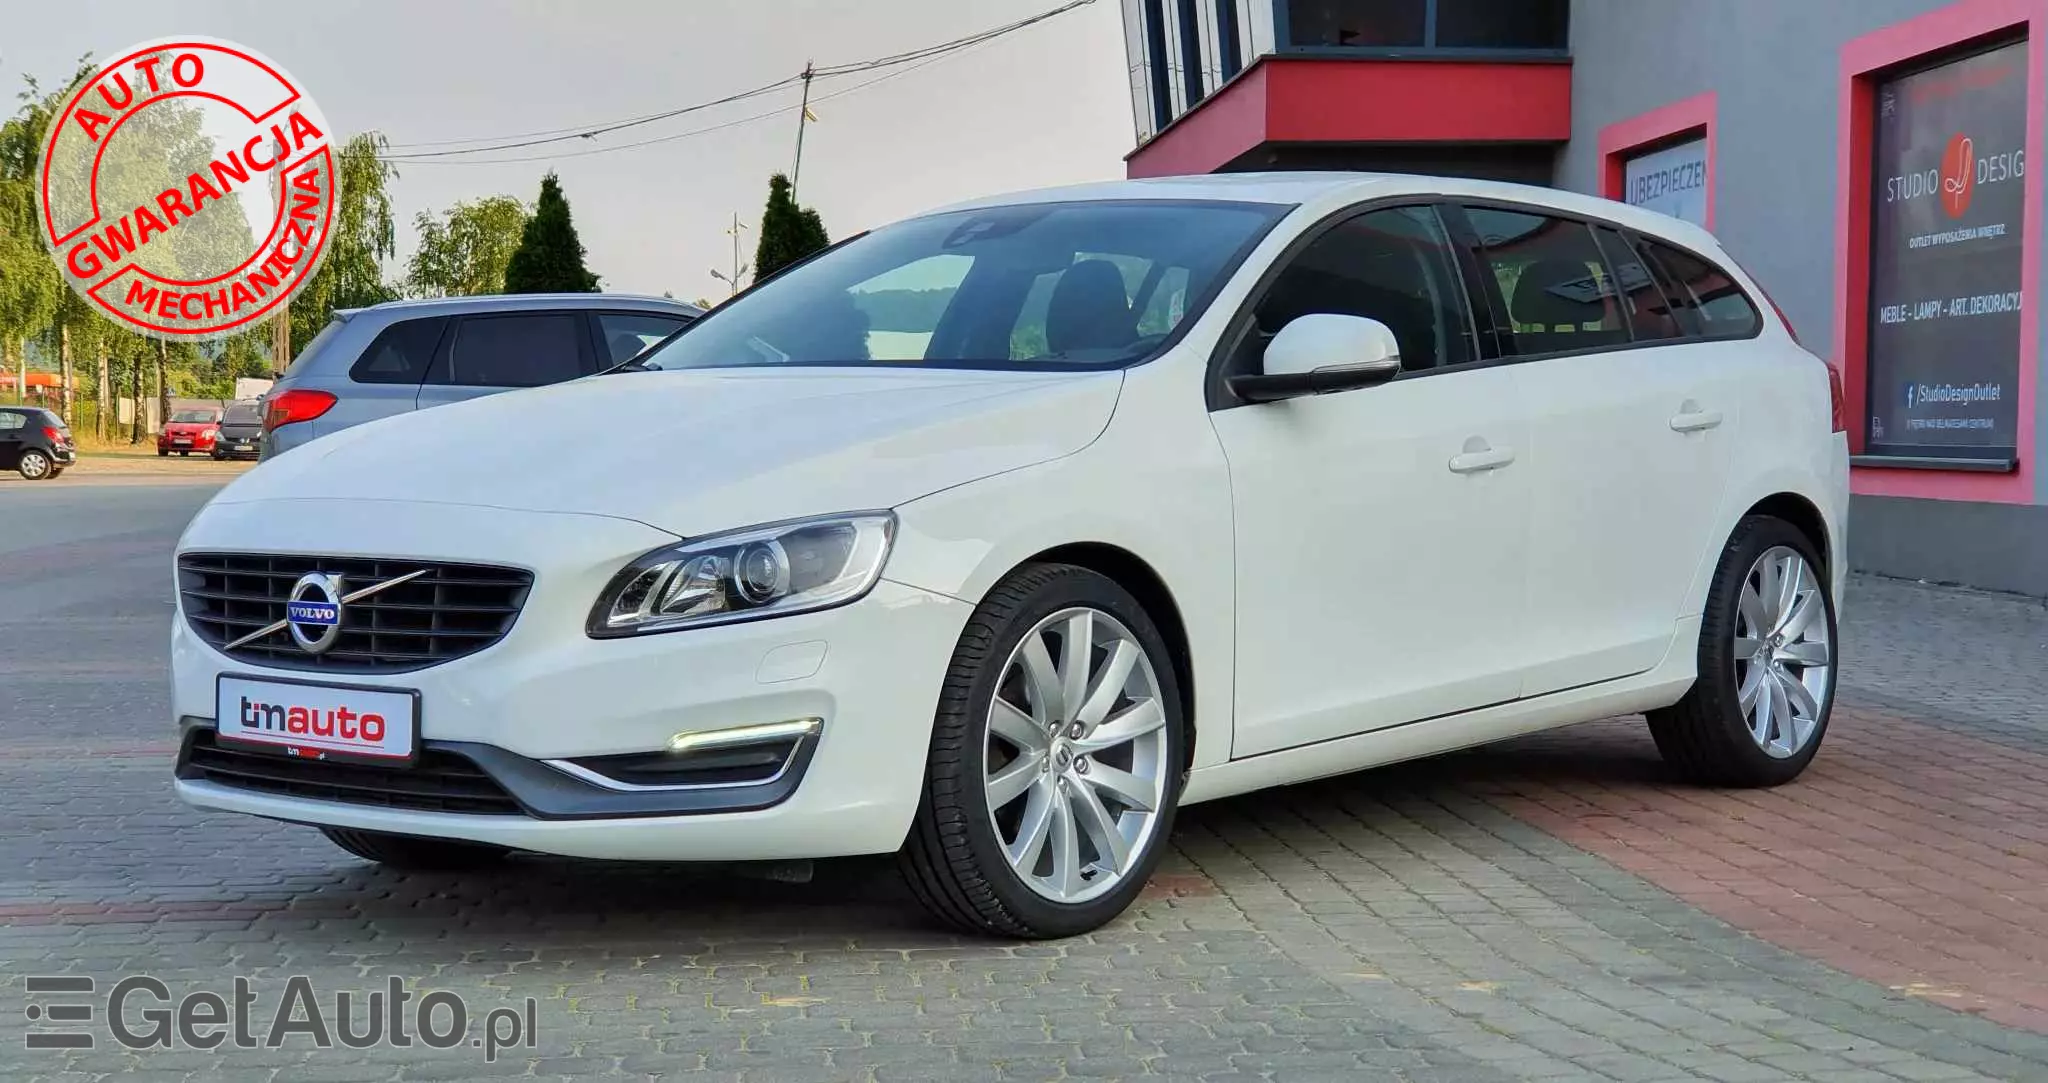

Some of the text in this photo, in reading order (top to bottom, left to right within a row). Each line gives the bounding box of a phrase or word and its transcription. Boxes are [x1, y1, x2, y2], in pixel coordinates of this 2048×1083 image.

[1887, 169, 1939, 202] STUDIO
[1909, 234, 1931, 248] OUTLET
[1880, 304, 1906, 324] MEBLE
[1914, 300, 1942, 320] LAMPY
[1949, 297, 1968, 316] ART.
[1916, 383, 2001, 406] /StudioDesignOutlet
[290, 606, 335, 620] VOLVO
[240, 696, 385, 742] timauto
